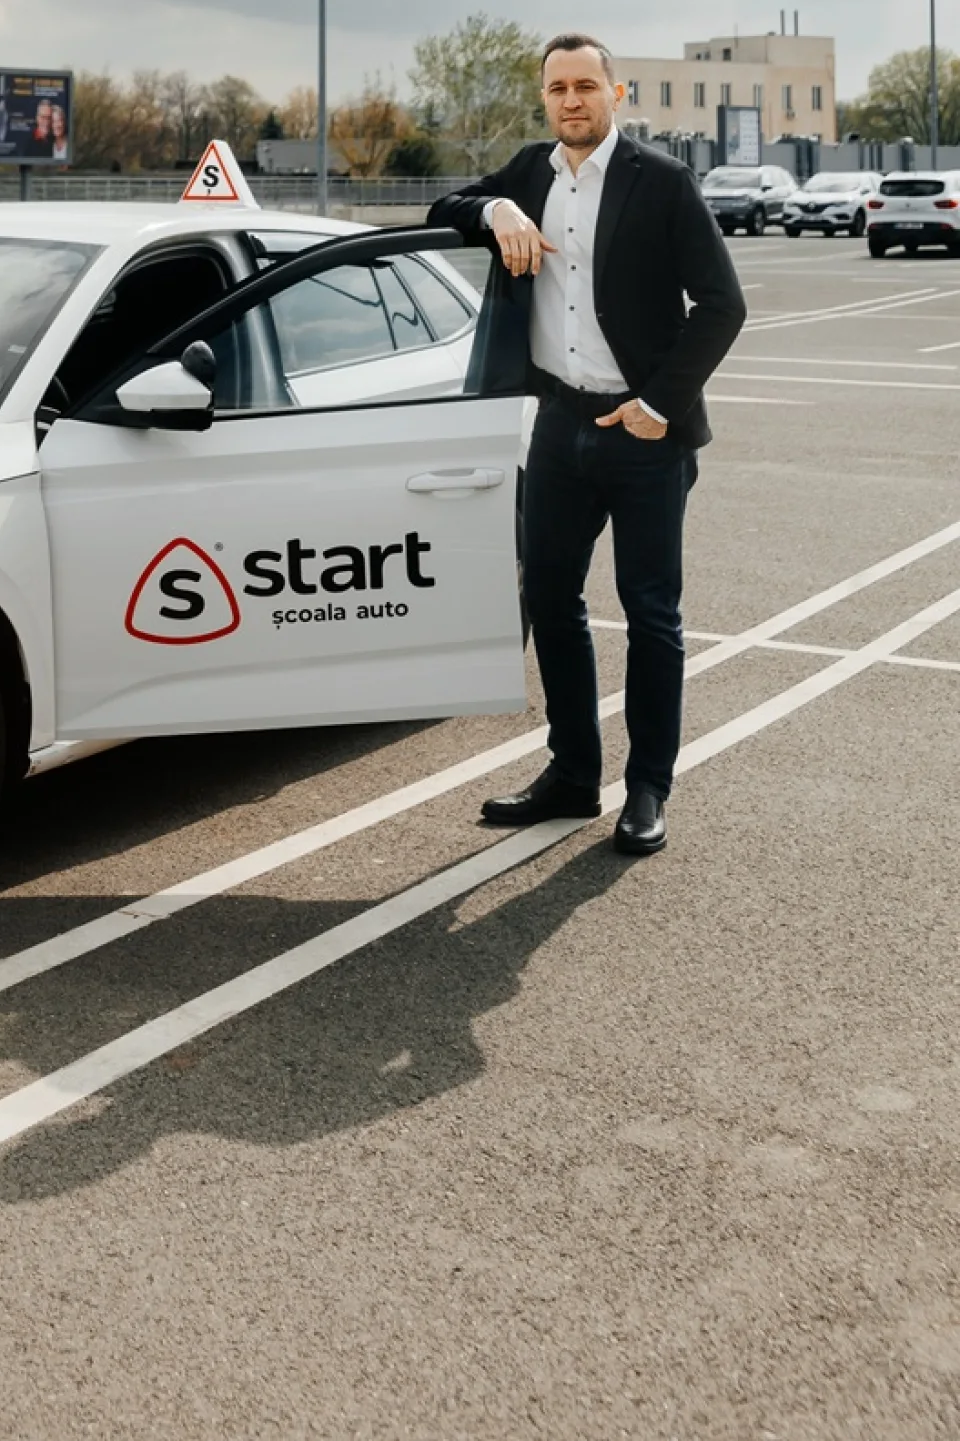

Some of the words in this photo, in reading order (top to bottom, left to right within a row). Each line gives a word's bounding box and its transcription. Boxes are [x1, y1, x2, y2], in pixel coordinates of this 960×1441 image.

[243, 531, 436, 597] start
[272, 602, 346, 630] școala
[356, 601, 409, 619] auto
